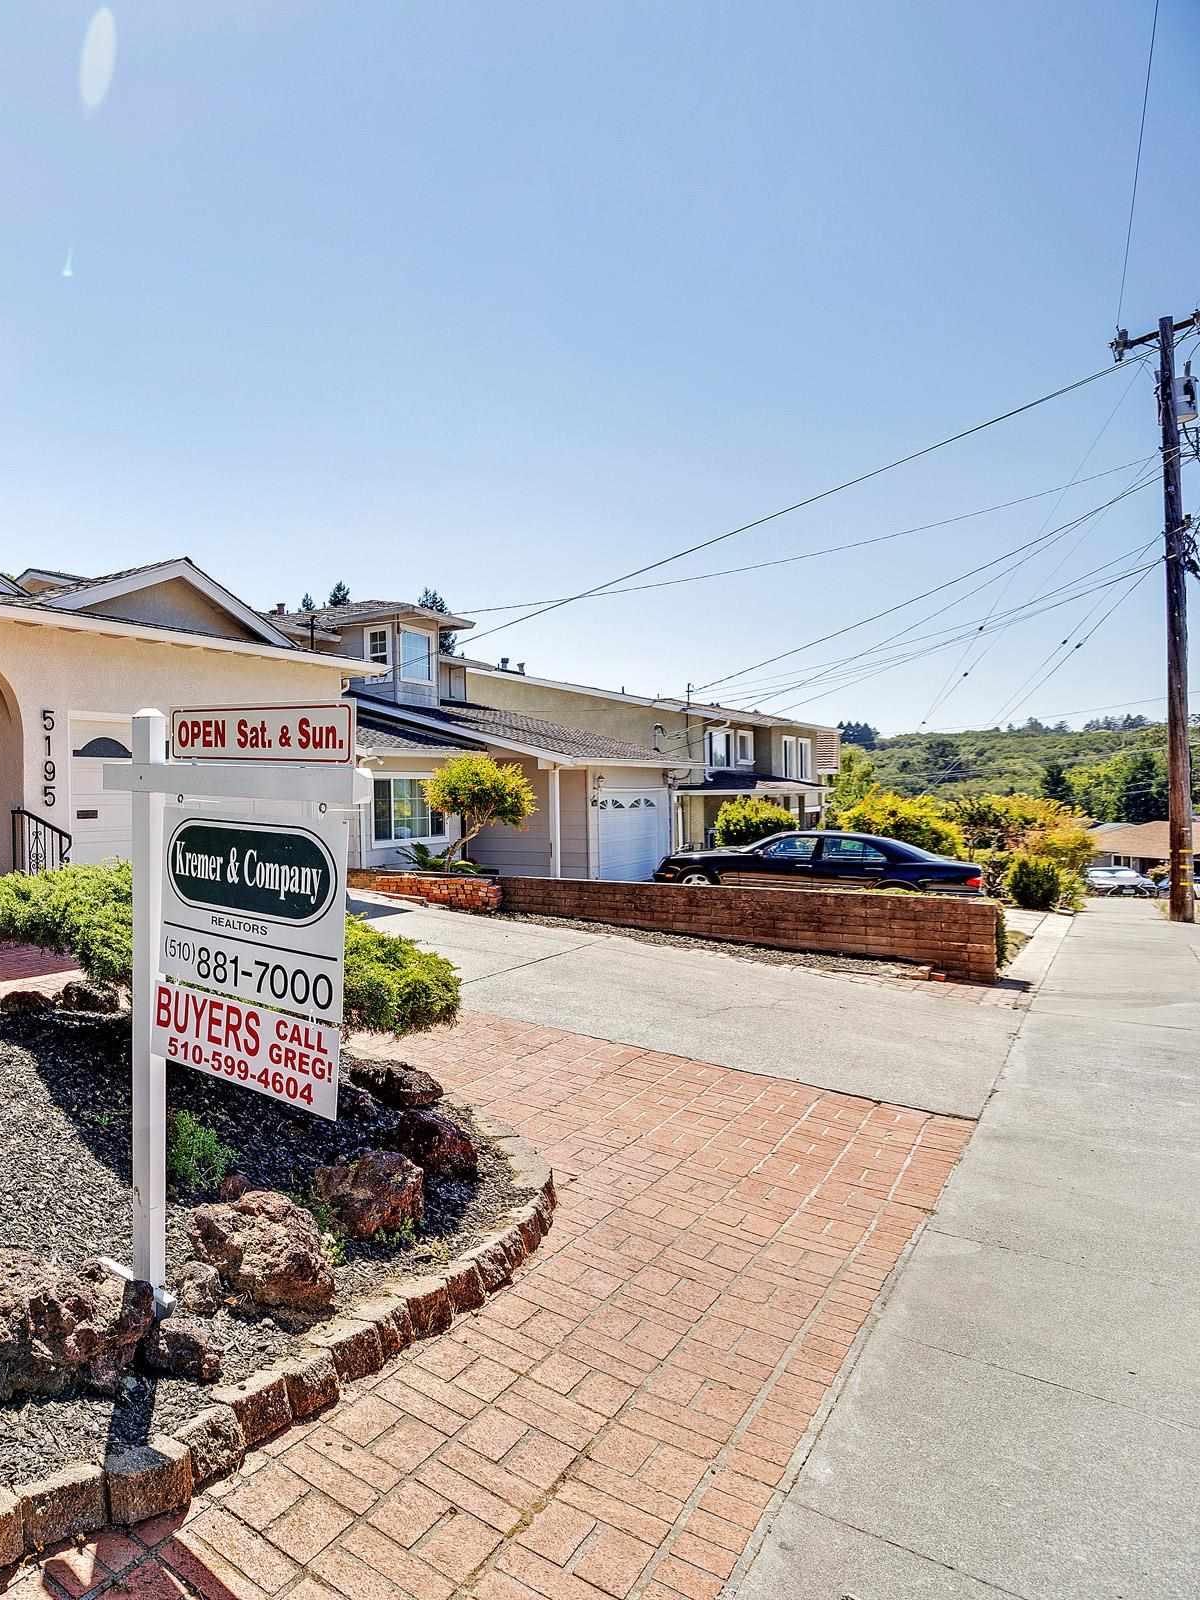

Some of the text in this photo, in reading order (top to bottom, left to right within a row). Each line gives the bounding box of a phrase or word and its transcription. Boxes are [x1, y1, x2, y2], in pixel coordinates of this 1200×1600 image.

[42, 710, 56, 807] 5195
[178, 717, 344, 750] OPEN Sat. & Sun.
[175, 840, 323, 904] Kremer & Company
[211, 916, 268, 935] REALTORS
[156, 986, 328, 1057] BUYERS CALL
[168, 1037, 313, 1105] 510-599-4604
[269, 1043, 333, 1083] GREG!
